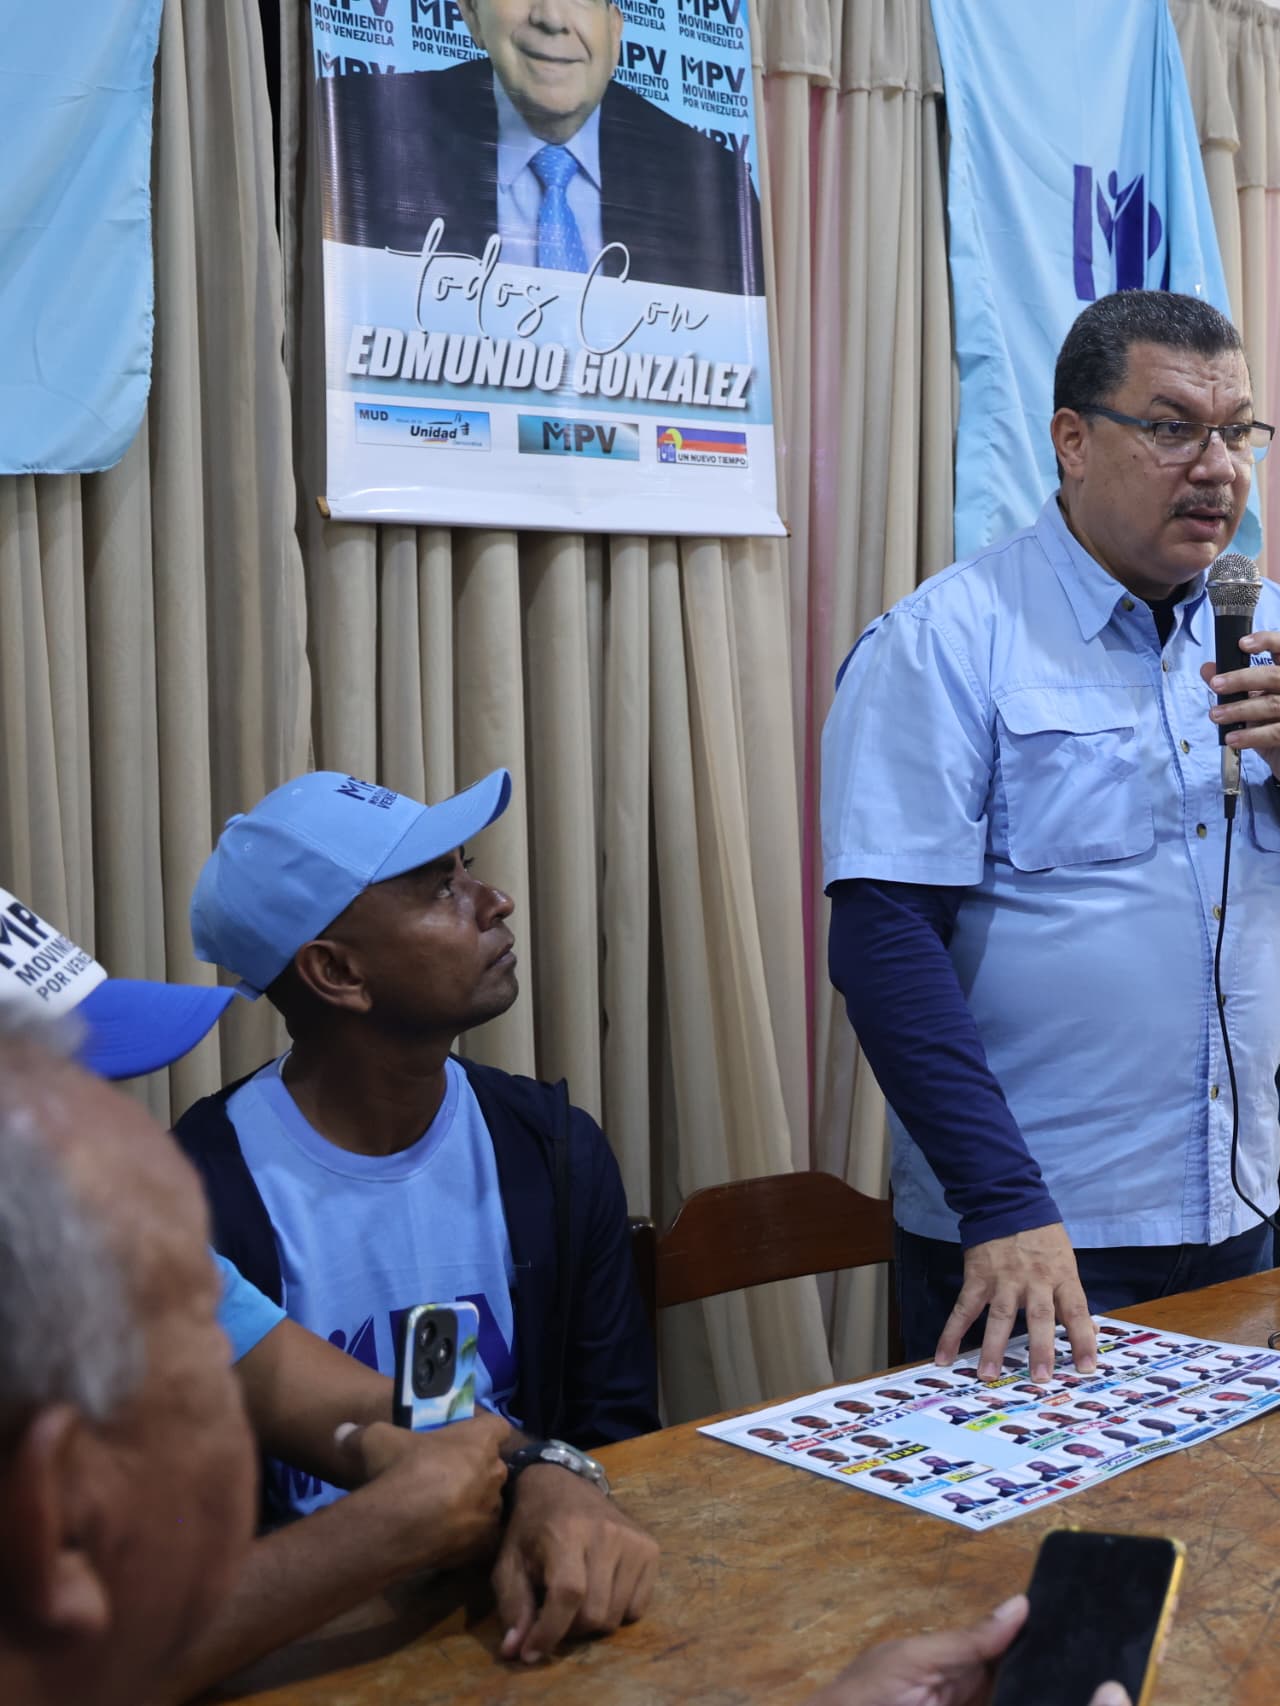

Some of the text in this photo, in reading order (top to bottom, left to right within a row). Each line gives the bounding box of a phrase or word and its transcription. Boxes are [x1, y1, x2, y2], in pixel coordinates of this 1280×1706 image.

[313, 4, 394, 34] MOVIMIENTO
[678, 12, 744, 39] MOVIMIENTO
[315, 19, 395, 47] POR VENEZUELA
[679, 27, 744, 50] POR VENEZUELA
[412, 40, 434, 55] POR
[681, 54, 746, 93] MPV
[682, 82, 748, 108] MOVIMIENTO
[683, 96, 749, 118] POR VENEZUELA
[580, 242, 709, 354] Con
[346, 325, 753, 409] EDMUNDO GONZÁLEZ
[359, 408, 389, 421] MUD
[410, 425, 458, 440] Unidad
[542, 420, 617, 455] MPV
[678, 453, 747, 465] UN NUEVO TIEMPO
[36, 971, 71, 1002] POR
